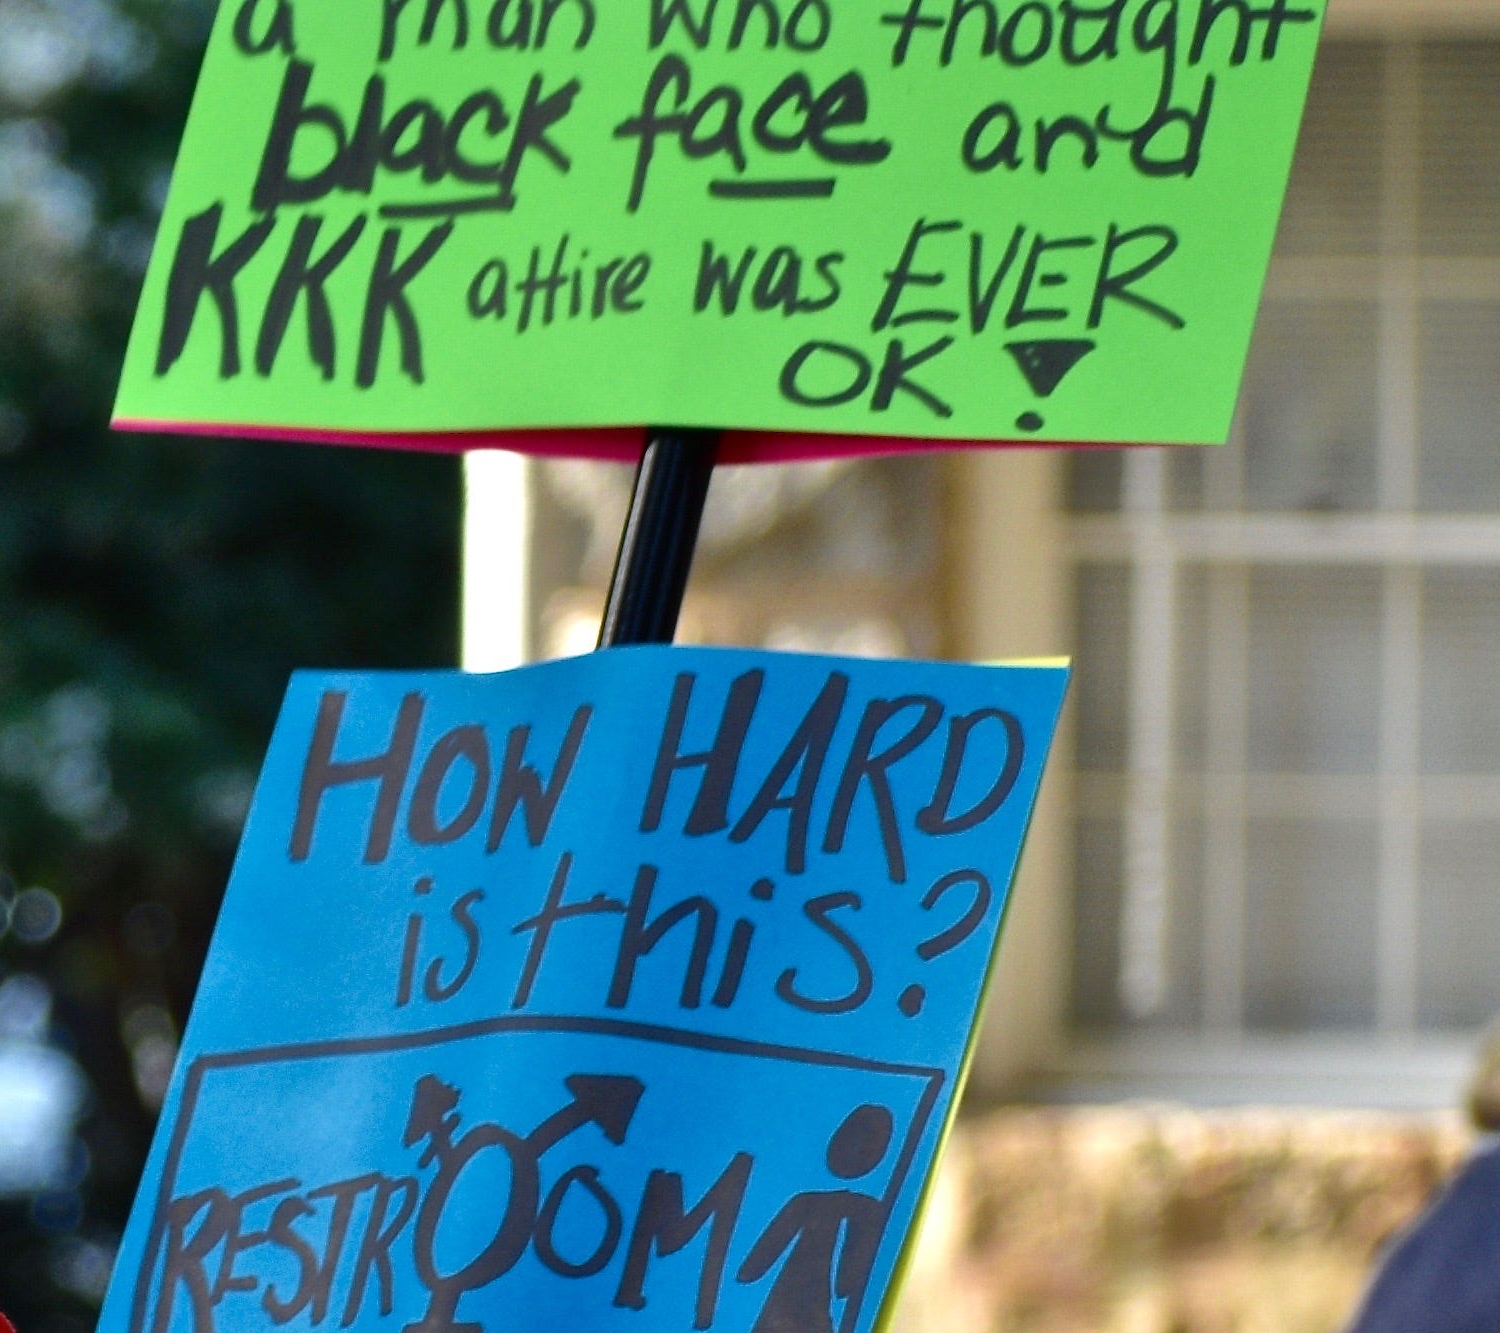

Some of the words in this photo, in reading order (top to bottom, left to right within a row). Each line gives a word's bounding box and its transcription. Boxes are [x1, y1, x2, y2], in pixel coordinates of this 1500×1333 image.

[231, 0, 297, 58] a
[250, 57, 582, 214] black
[611, 52, 893, 214] face
[960, 73, 1216, 178] and
[152, 199, 456, 390] KKK
[464, 232, 653, 335] attire
[692, 238, 846, 318] was
[869, 216, 1187, 335] EVER
[637, 667, 1027, 885] HARD
[394, 876, 488, 1012] is
[511, 850, 993, 1019] this?
